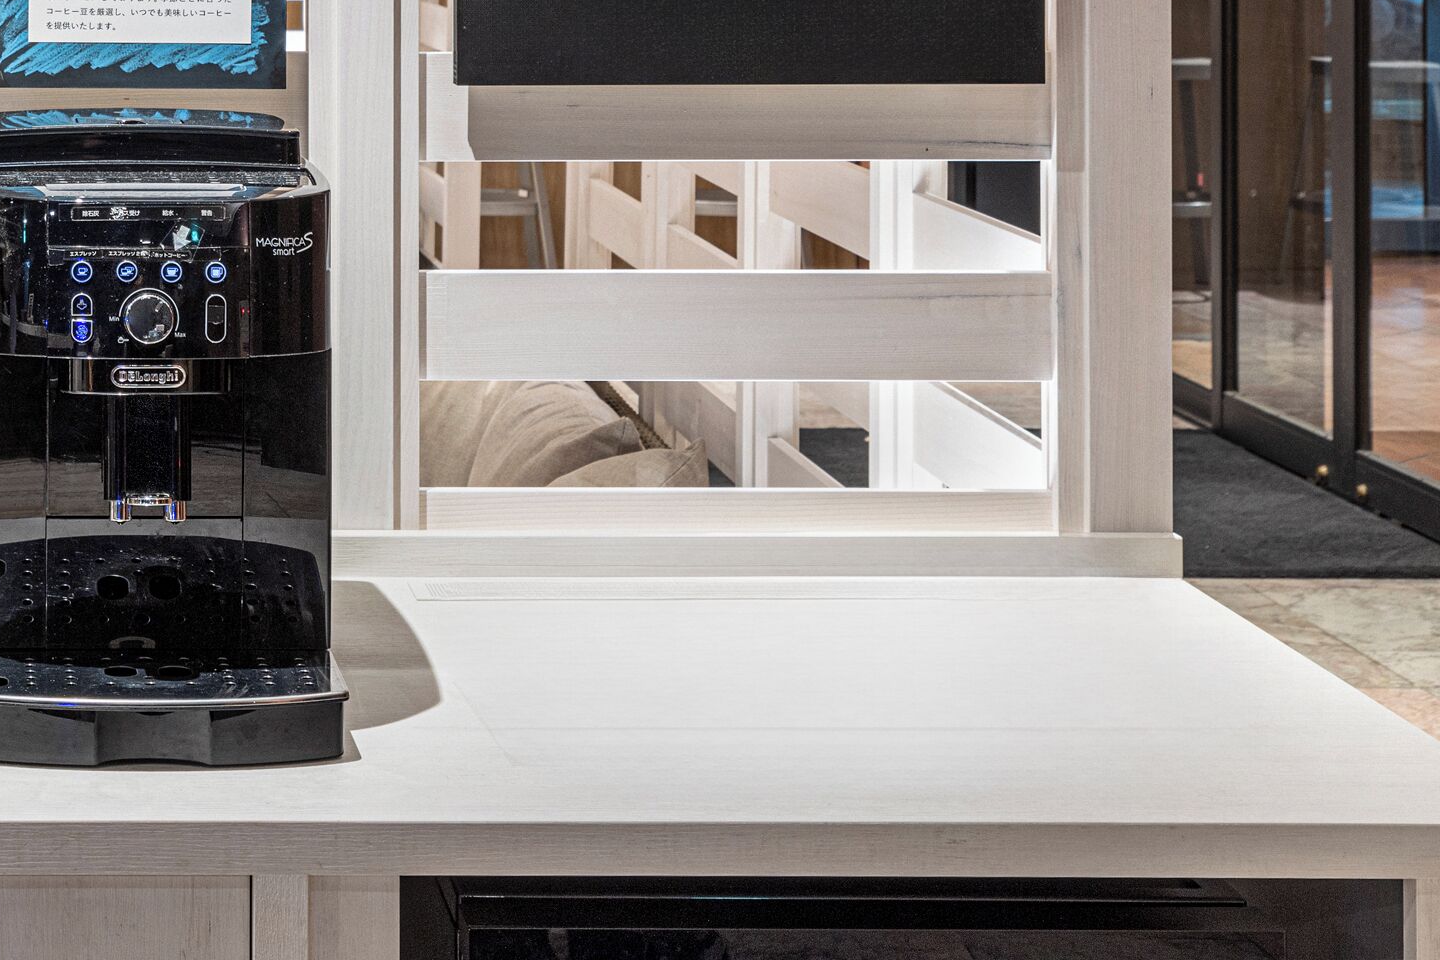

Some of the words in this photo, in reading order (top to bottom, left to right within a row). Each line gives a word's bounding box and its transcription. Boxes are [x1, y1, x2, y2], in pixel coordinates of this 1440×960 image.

[46, 21, 117, 31] を提供いたします。
[272, 247, 295, 256] smart
